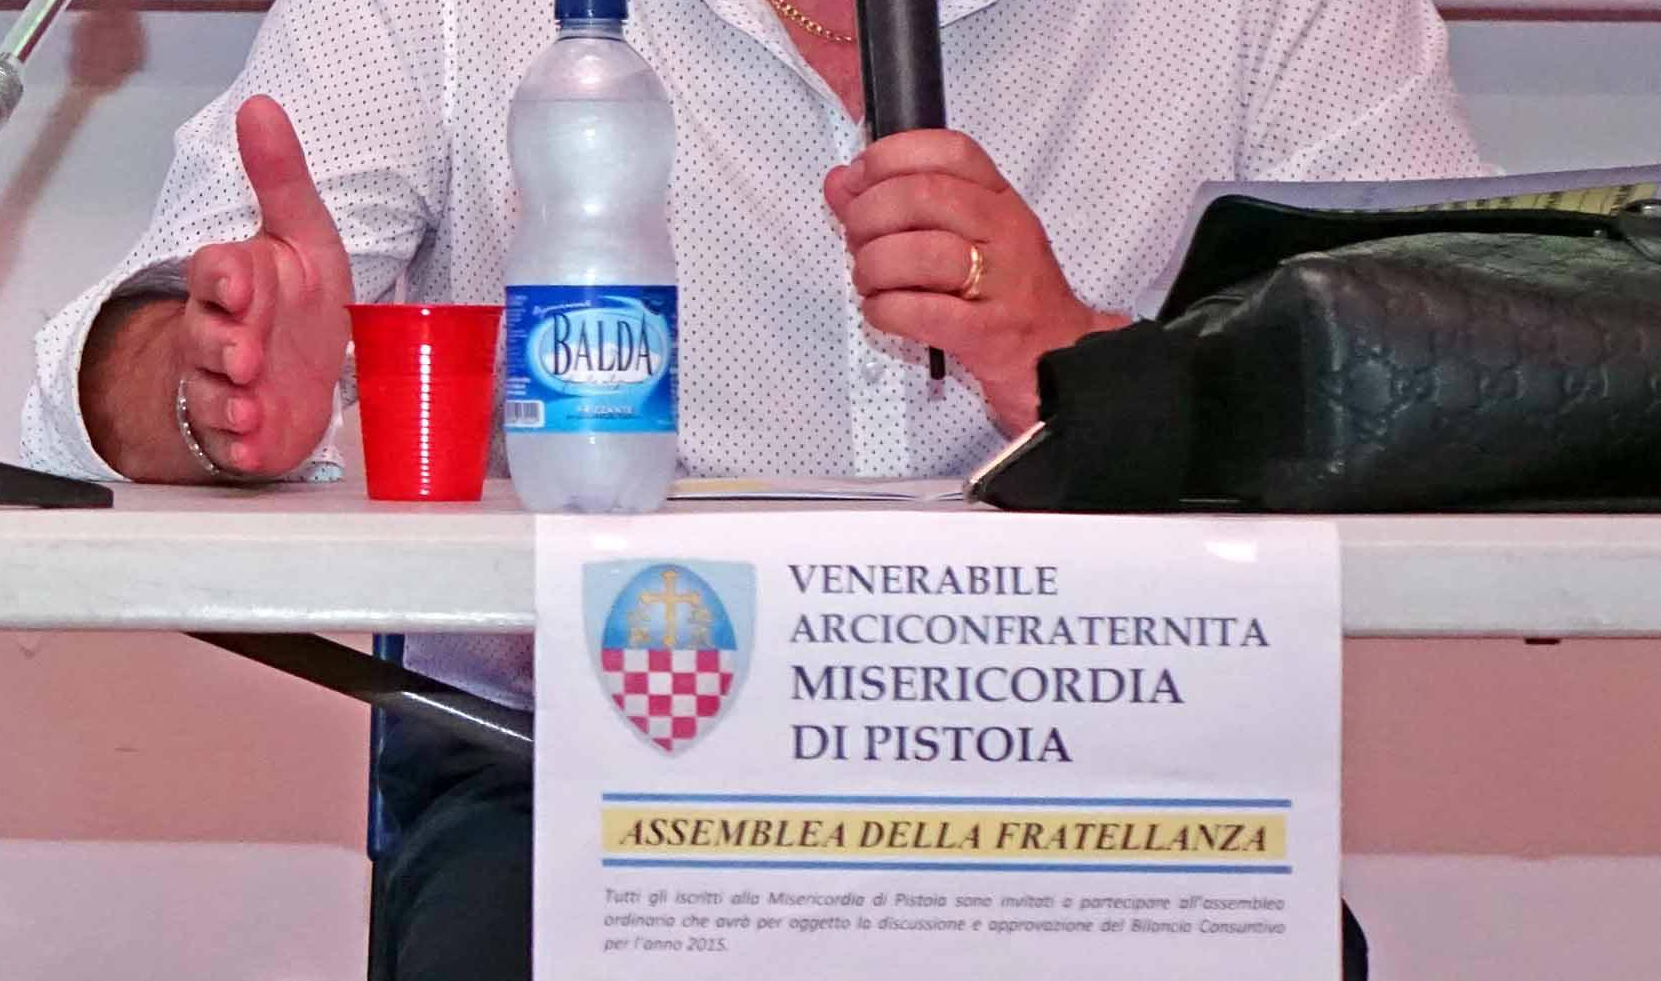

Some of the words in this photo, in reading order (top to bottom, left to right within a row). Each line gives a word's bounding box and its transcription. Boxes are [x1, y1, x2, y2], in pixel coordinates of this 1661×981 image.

[552, 312, 655, 376] BALDA
[788, 563, 1059, 597] VENERABILE
[788, 613, 1269, 648] ARCICONFRATERNITA
[789, 664, 1185, 705] MISERICORDIA
[792, 724, 846, 761] DI
[864, 726, 1073, 764] PISTOIA
[617, 817, 847, 848] ASSEMBLEA
[857, 821, 982, 851] DELLA
[994, 822, 1268, 853] FRATELLANZA
